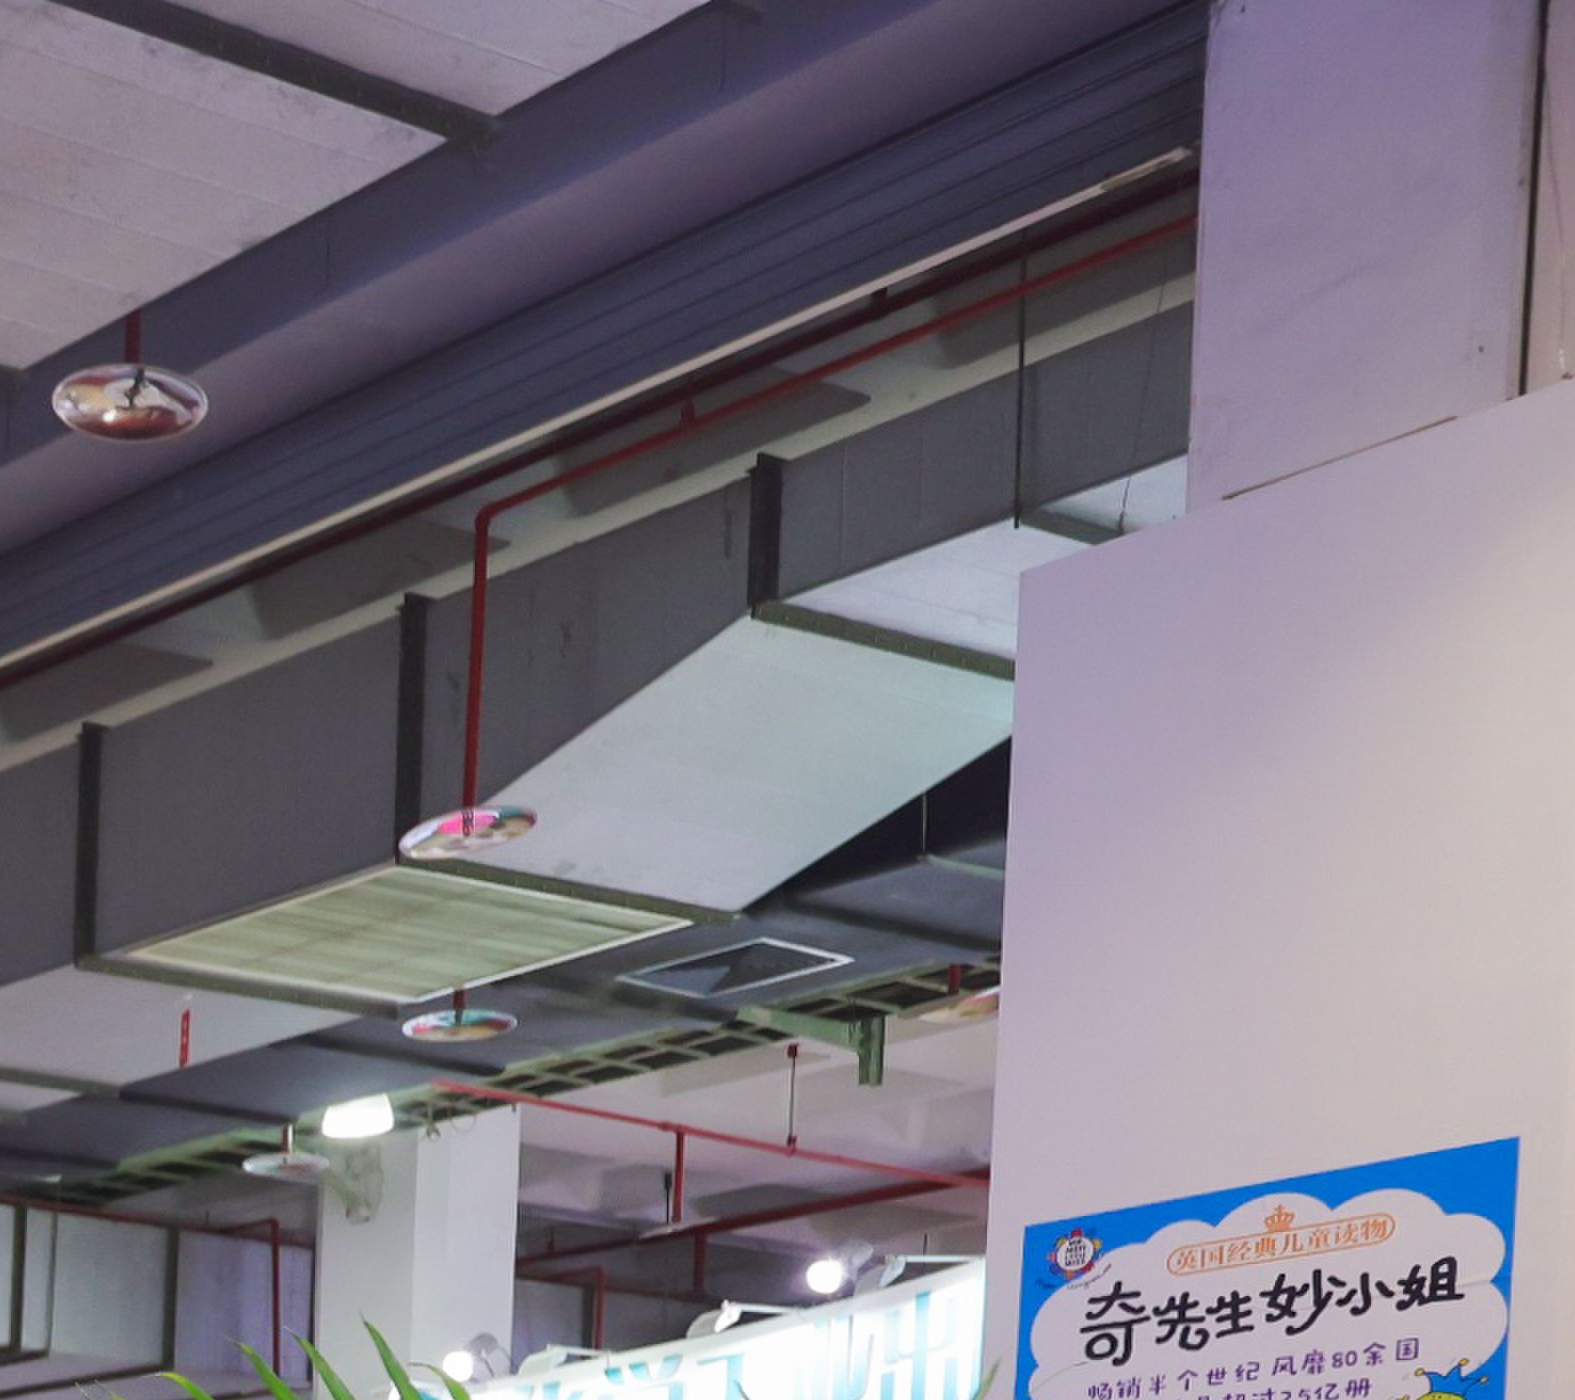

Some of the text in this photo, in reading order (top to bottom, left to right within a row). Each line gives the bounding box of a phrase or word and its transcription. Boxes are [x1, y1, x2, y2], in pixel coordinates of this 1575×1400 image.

[1174, 1216, 1389, 1273] 英国经典儿童读物
[1080, 1256, 1465, 1367] 奇先生妙小姐
